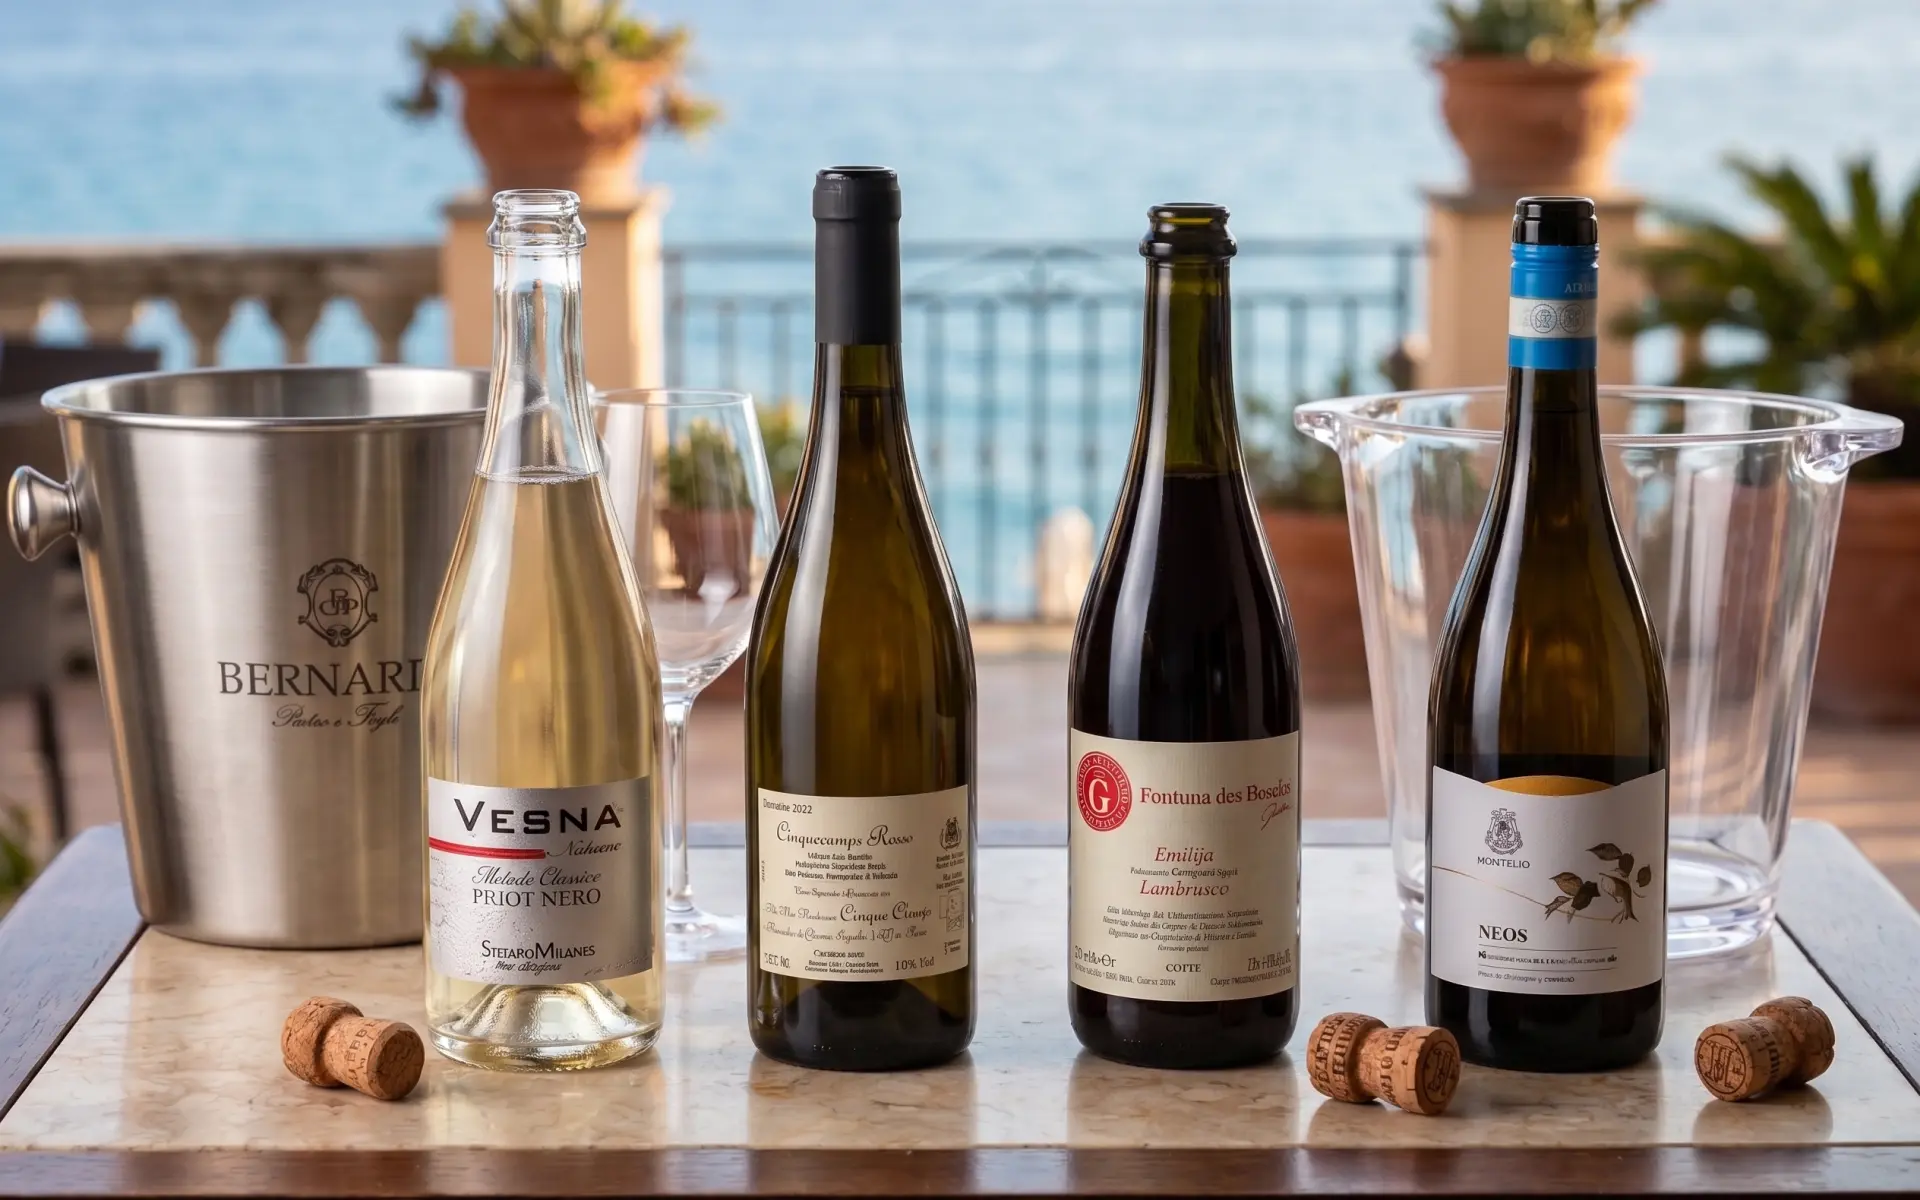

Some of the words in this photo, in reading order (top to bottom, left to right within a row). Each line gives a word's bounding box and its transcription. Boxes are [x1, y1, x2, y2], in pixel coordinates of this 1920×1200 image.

[1140, 788, 1212, 805] Fontuna
[1217, 788, 1243, 804] des
[454, 798, 621, 835] VESNA
[792, 804, 813, 815] 2022
[866, 825, 914, 847] Rosso
[1154, 847, 1215, 866] Emilija
[1477, 856, 1531, 869] MONTELIO
[1139, 879, 1230, 897] Lambrusco
[473, 888, 535, 908] PRIOT
[542, 888, 602, 907] NERO
[840, 903, 889, 926] Cinque
[1478, 924, 1528, 943] NEOS
[895, 959, 917, 971] 10%
